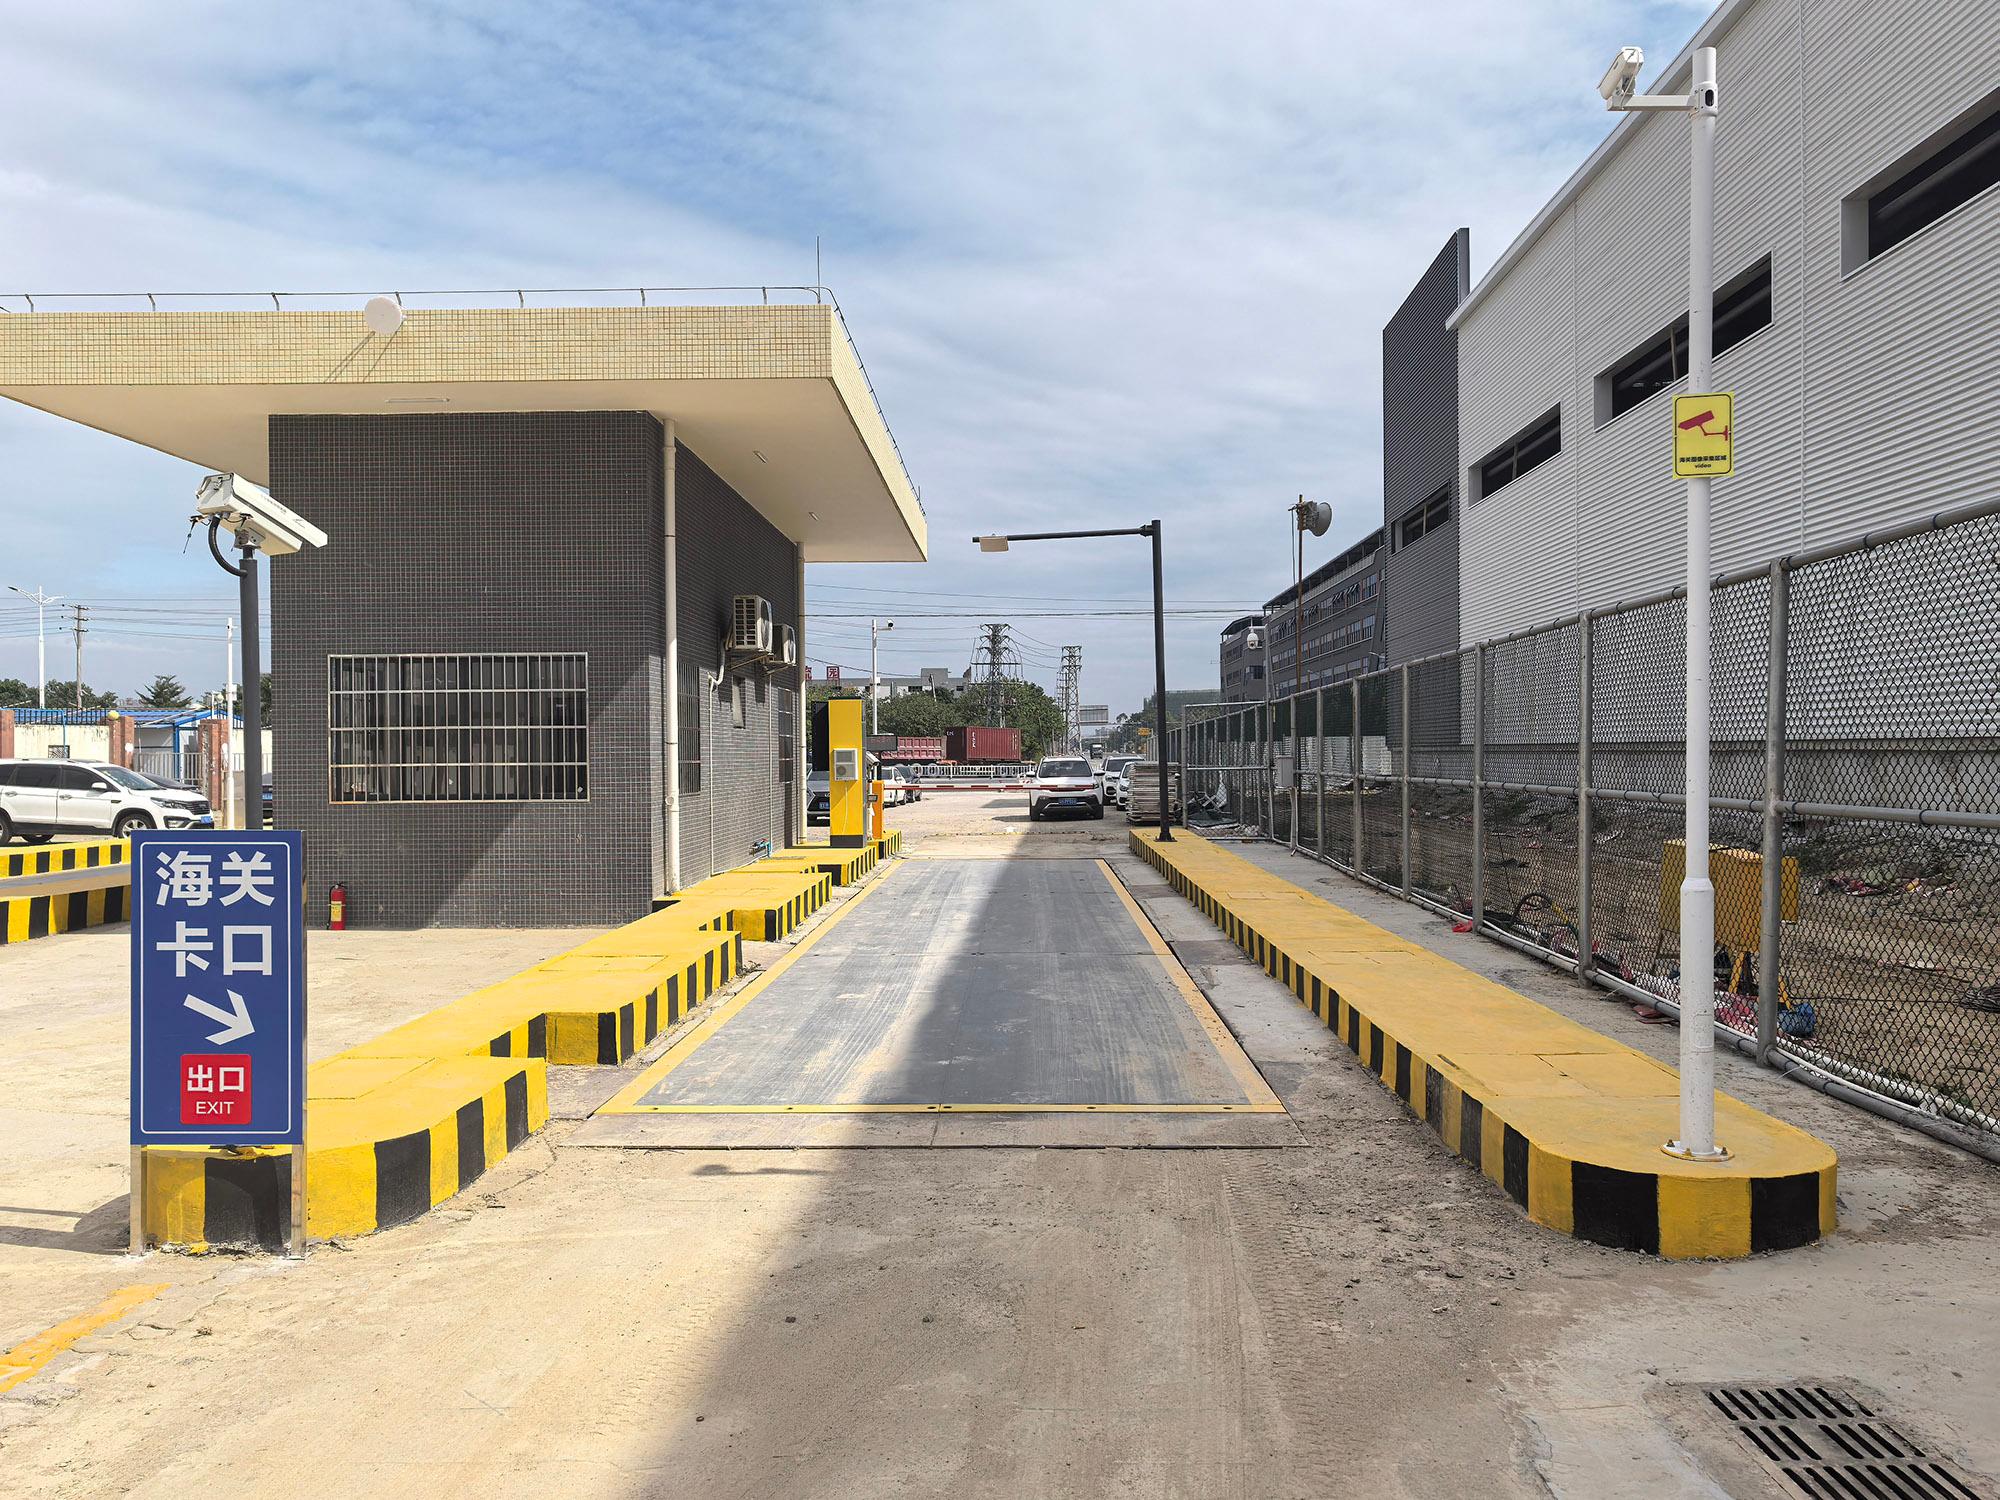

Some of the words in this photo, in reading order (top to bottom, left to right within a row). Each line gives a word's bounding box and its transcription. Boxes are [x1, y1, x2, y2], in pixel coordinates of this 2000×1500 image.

[155, 850, 275, 907] 海关
[156, 921, 273, 977] 卡口
[187, 1064, 245, 1093] 出口
[195, 1101, 235, 1115] EXIT
